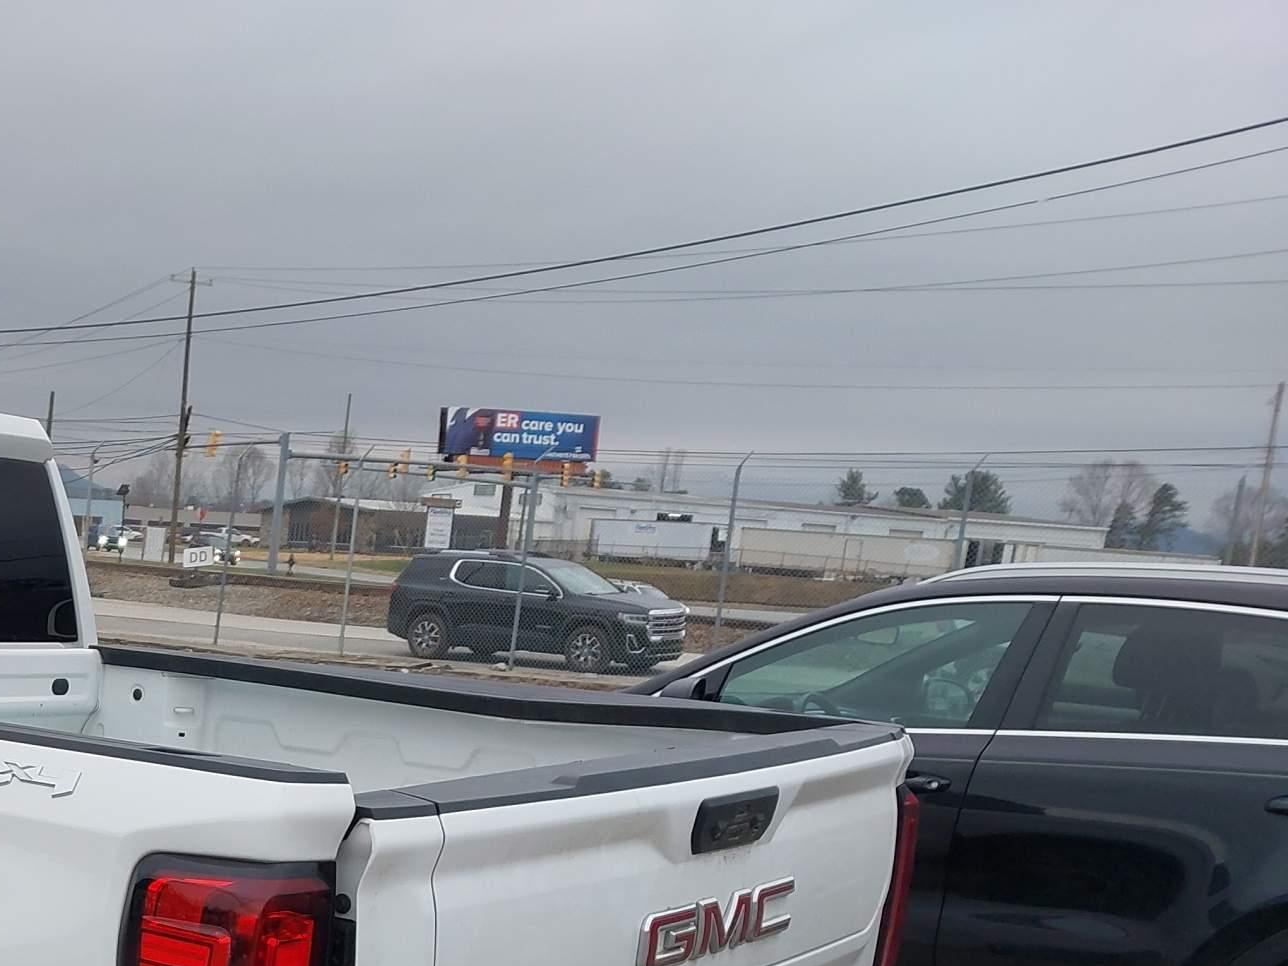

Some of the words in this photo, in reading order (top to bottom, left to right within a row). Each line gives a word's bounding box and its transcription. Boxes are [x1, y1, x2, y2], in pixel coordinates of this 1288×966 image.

[496, 413, 519, 428] ER
[521, 419, 554, 432] care
[556, 421, 584, 435] you
[493, 432, 520, 443] can
[522, 432, 560, 446] trust.
